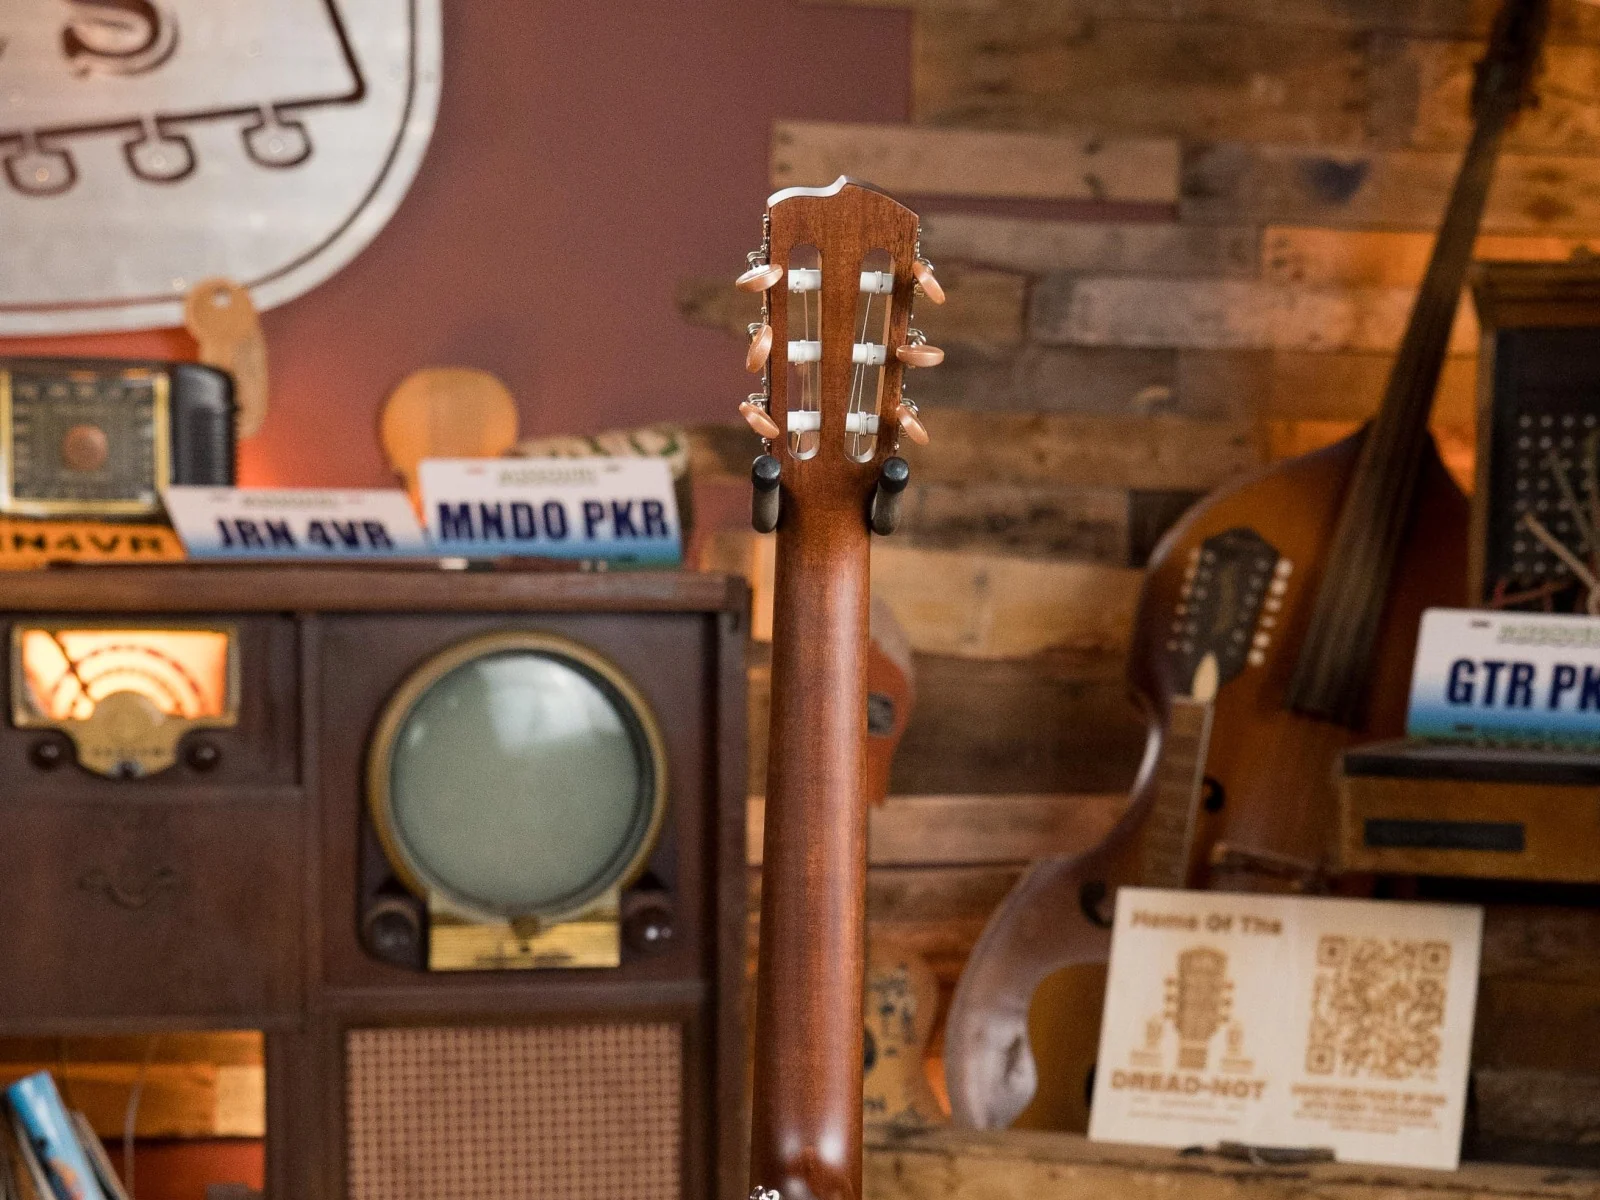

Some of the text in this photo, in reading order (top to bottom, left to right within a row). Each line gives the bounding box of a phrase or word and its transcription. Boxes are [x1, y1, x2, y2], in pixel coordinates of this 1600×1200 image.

[437, 499, 668, 541] MNDO PKR
[1447, 658, 1536, 709] GTR
